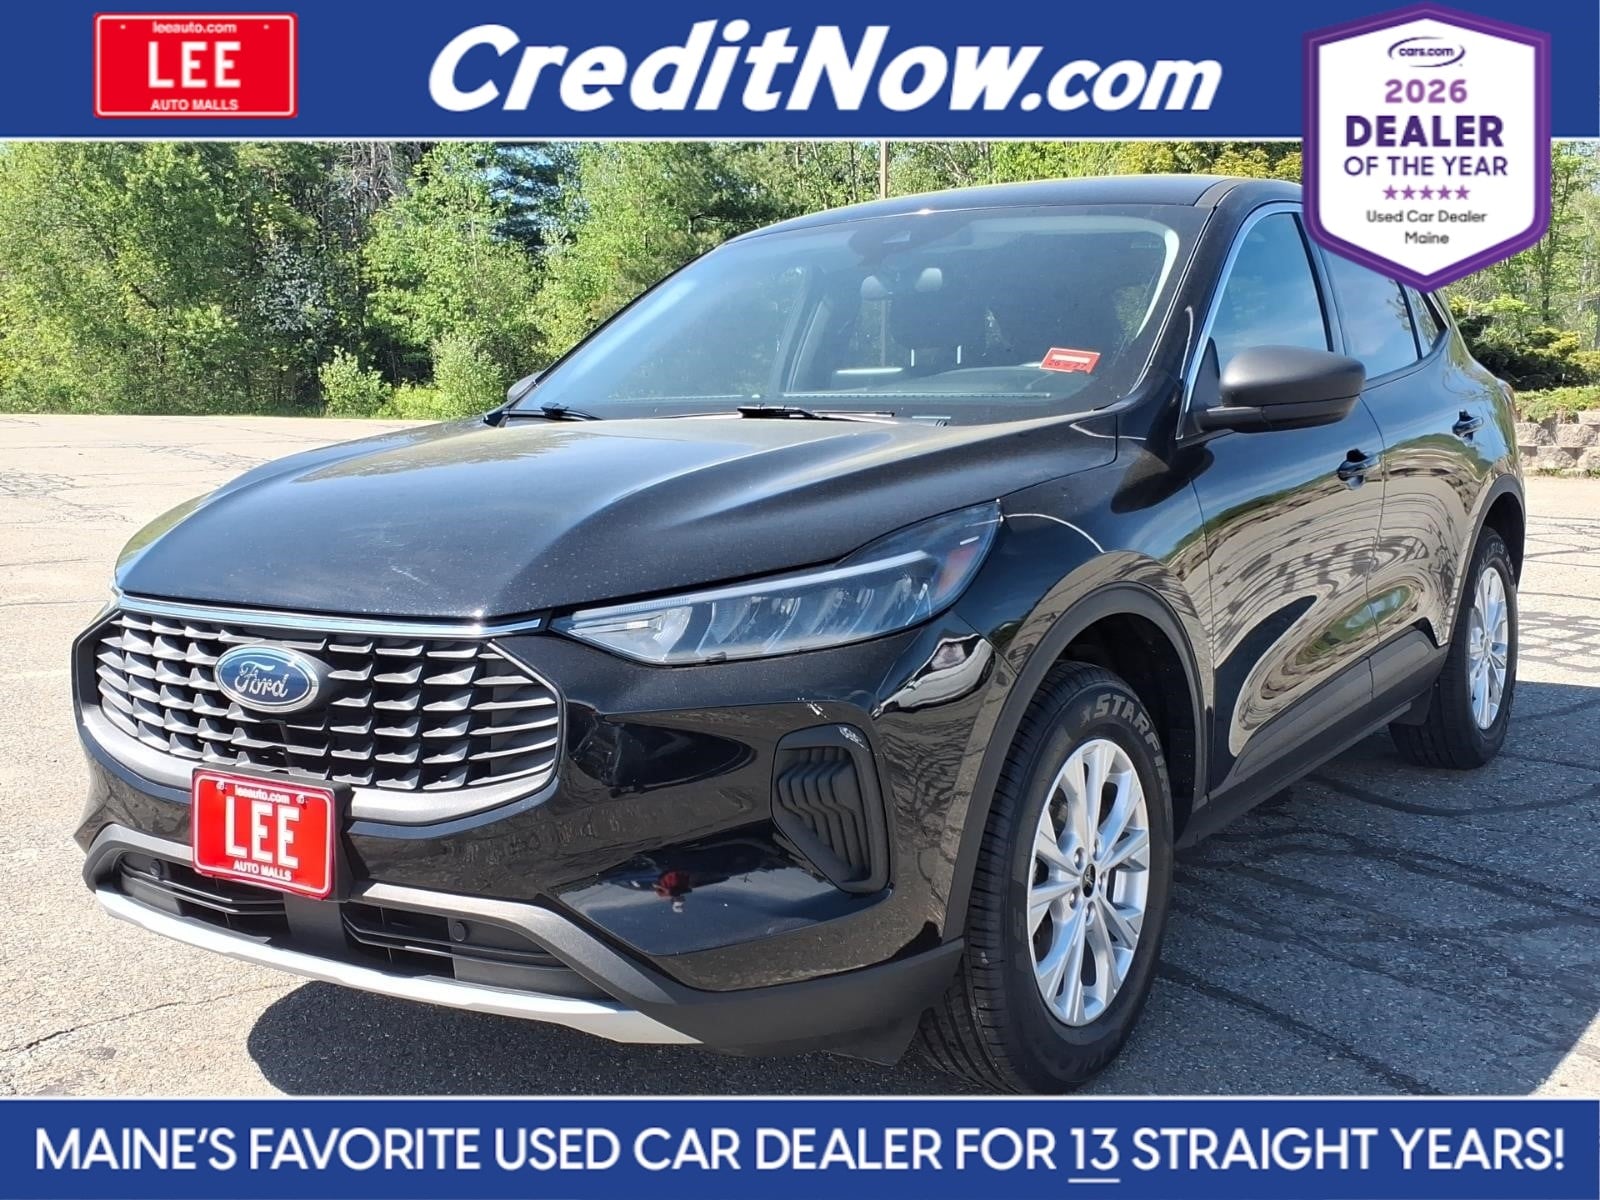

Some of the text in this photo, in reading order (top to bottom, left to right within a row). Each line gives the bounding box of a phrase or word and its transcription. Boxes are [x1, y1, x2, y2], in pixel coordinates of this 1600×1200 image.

[234, 661, 289, 698] Ford
[234, 784, 291, 805] leeauto.com
[226, 796, 299, 869] LEE
[233, 860, 292, 881] AUTO MALLS
